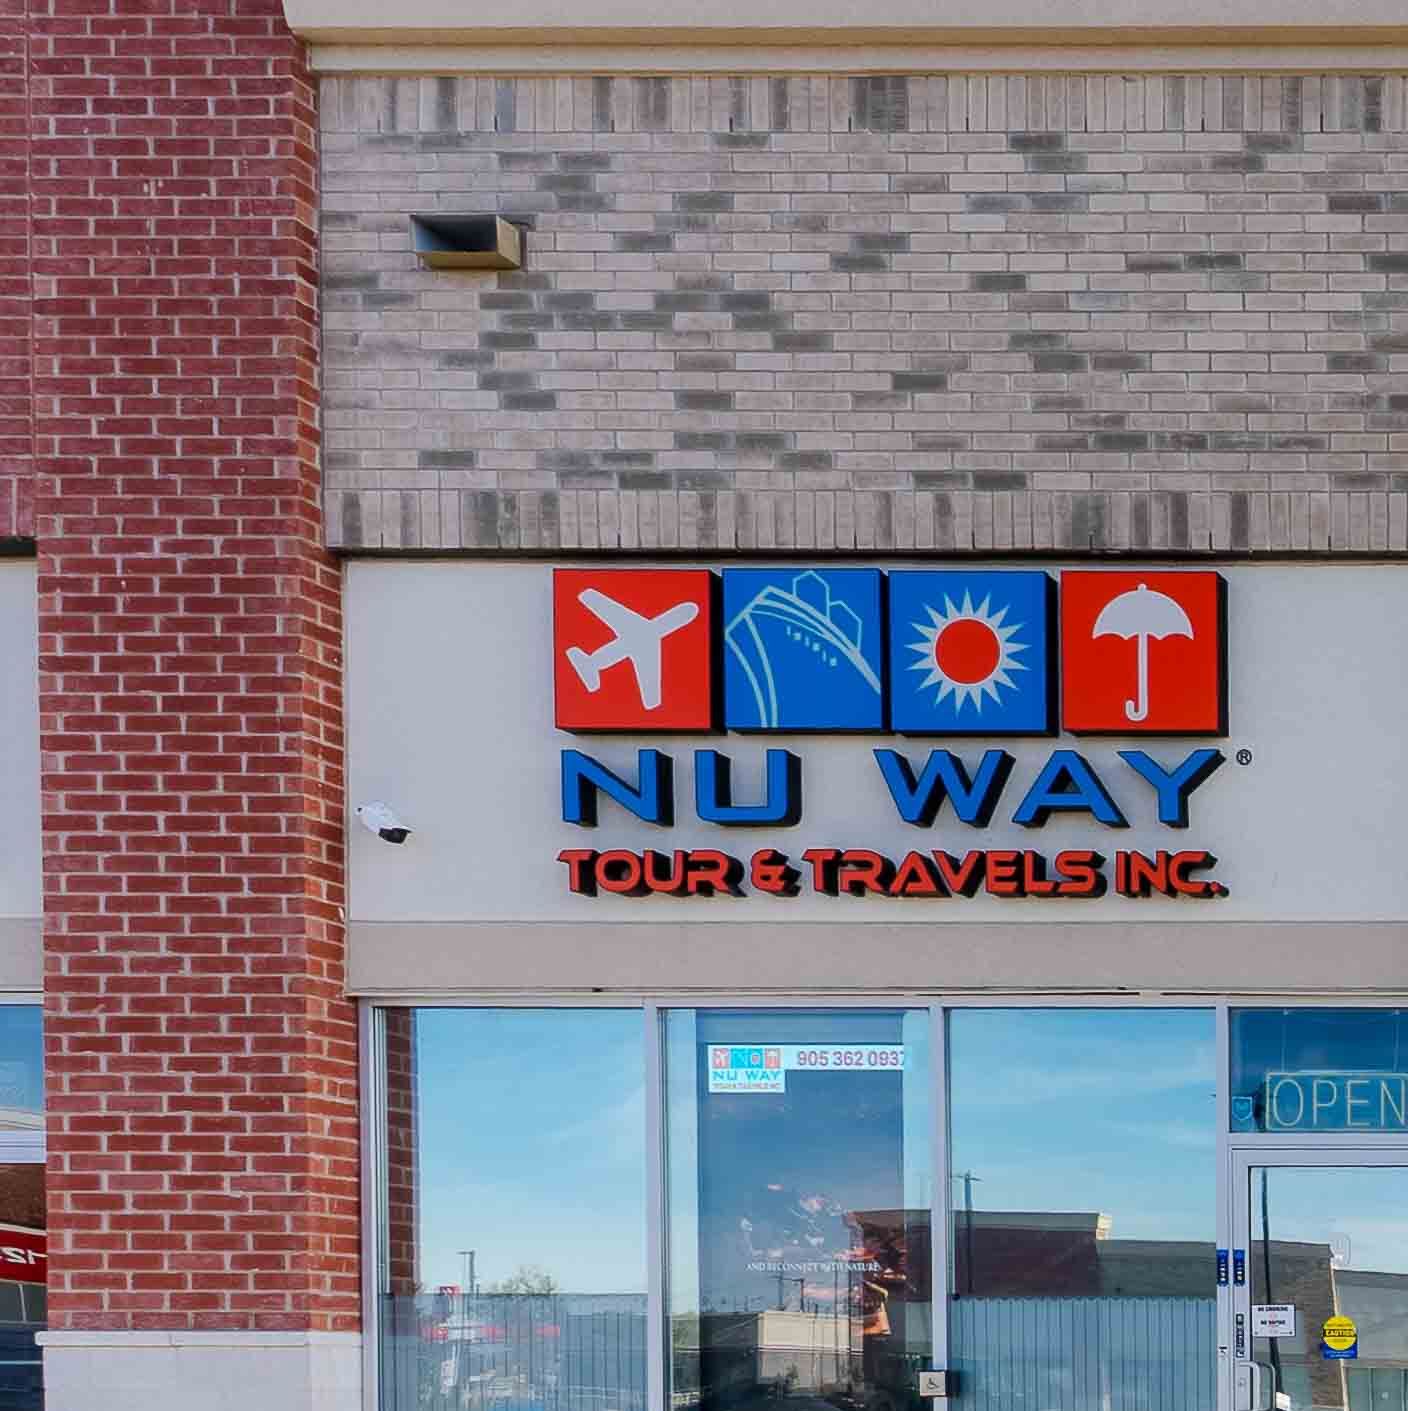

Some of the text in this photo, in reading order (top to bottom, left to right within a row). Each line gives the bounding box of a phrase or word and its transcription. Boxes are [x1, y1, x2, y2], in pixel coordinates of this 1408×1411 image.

[560, 749, 1226, 828] NU WAY
[557, 849, 1229, 897] TOUR & TRAVELS INC.
[713, 1070, 781, 1081] NU WAY
[797, 1050, 829, 1067] 905
[833, 1050, 864, 1067] 362
[1273, 1077, 1407, 1127] OPEN
